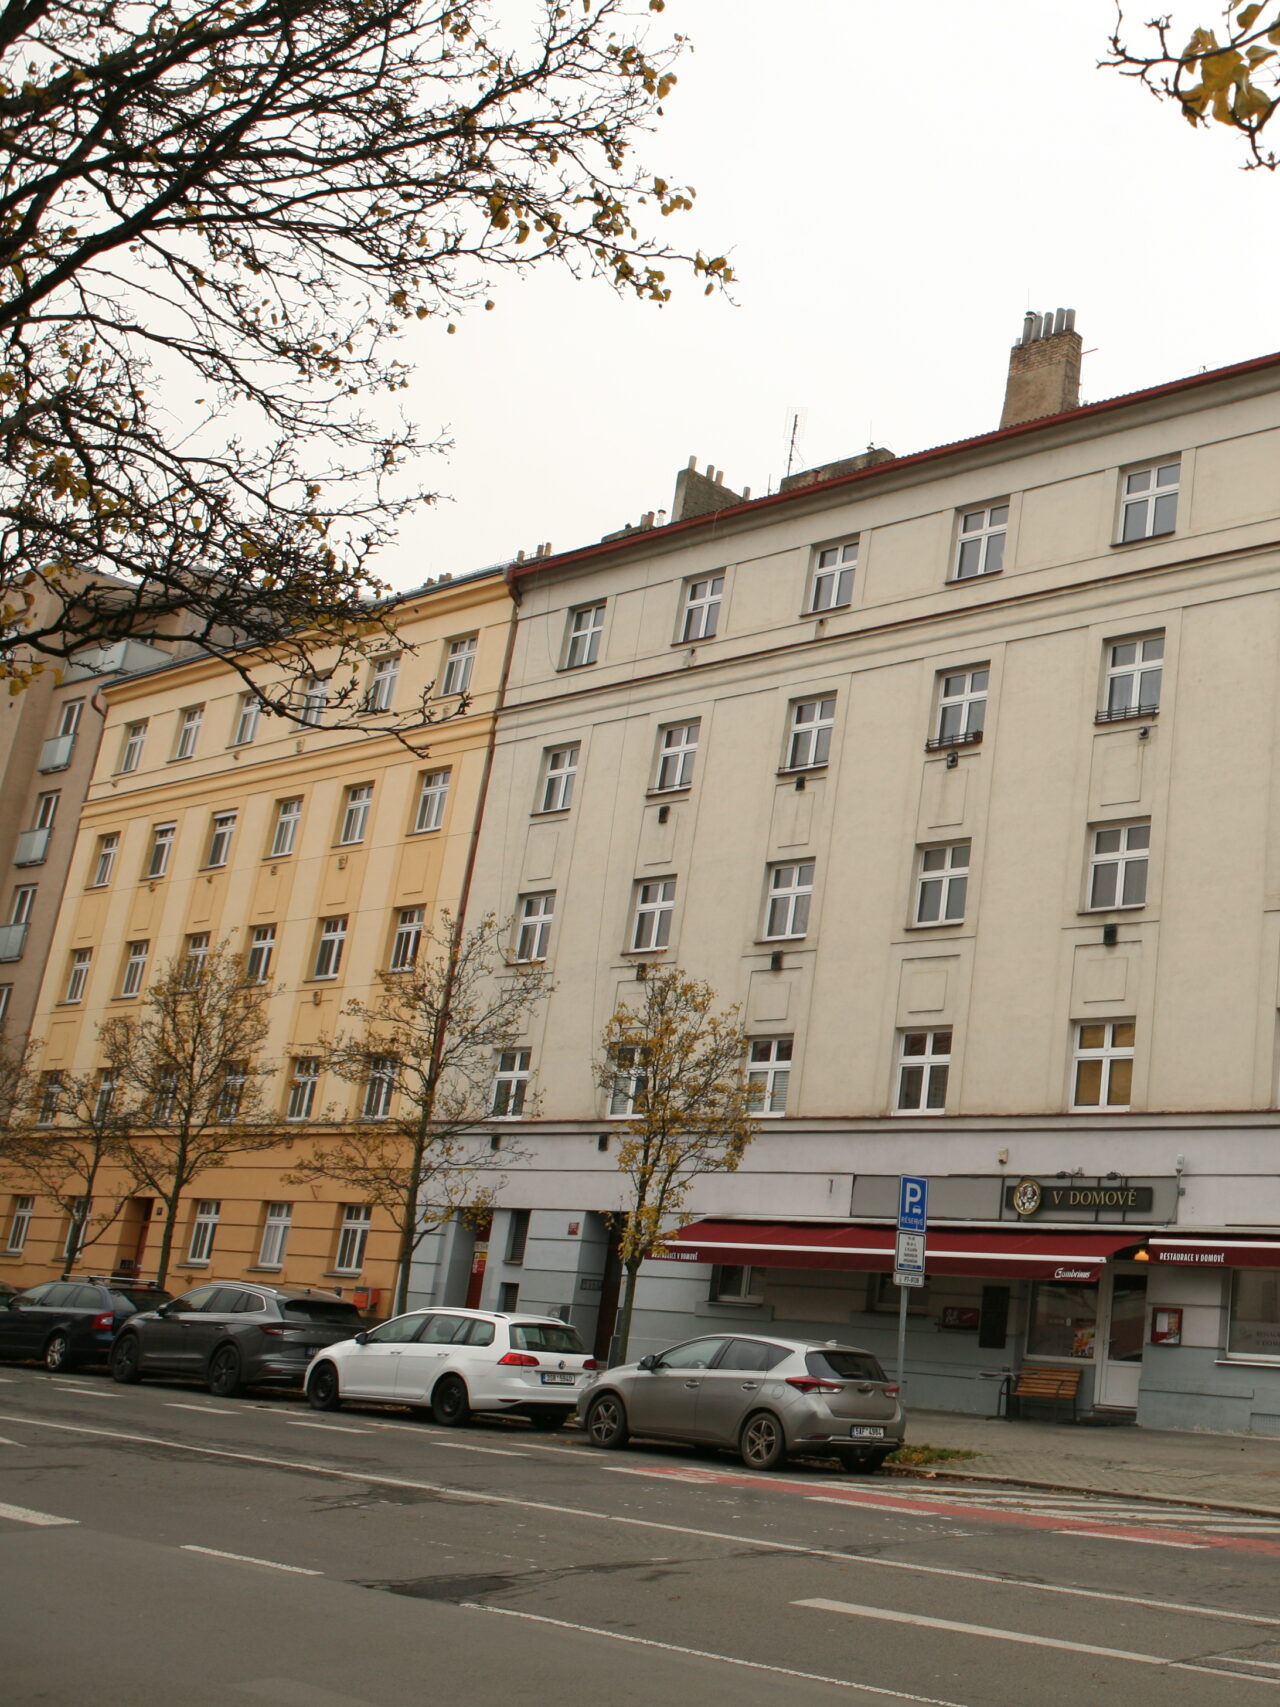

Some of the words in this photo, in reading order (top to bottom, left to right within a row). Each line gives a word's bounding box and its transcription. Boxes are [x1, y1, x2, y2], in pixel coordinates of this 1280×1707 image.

[905, 1183, 921, 1213] P
[1052, 1190, 1063, 1205] V
[1069, 1189, 1137, 1206] DOMOVĚ
[1160, 1252, 1194, 1261] RESTAURACE
[1195, 1254, 1200, 1262] V
[1200, 1252, 1225, 1263] DOMOVĚ
[1054, 1267, 1091, 1279] Gambrinus
